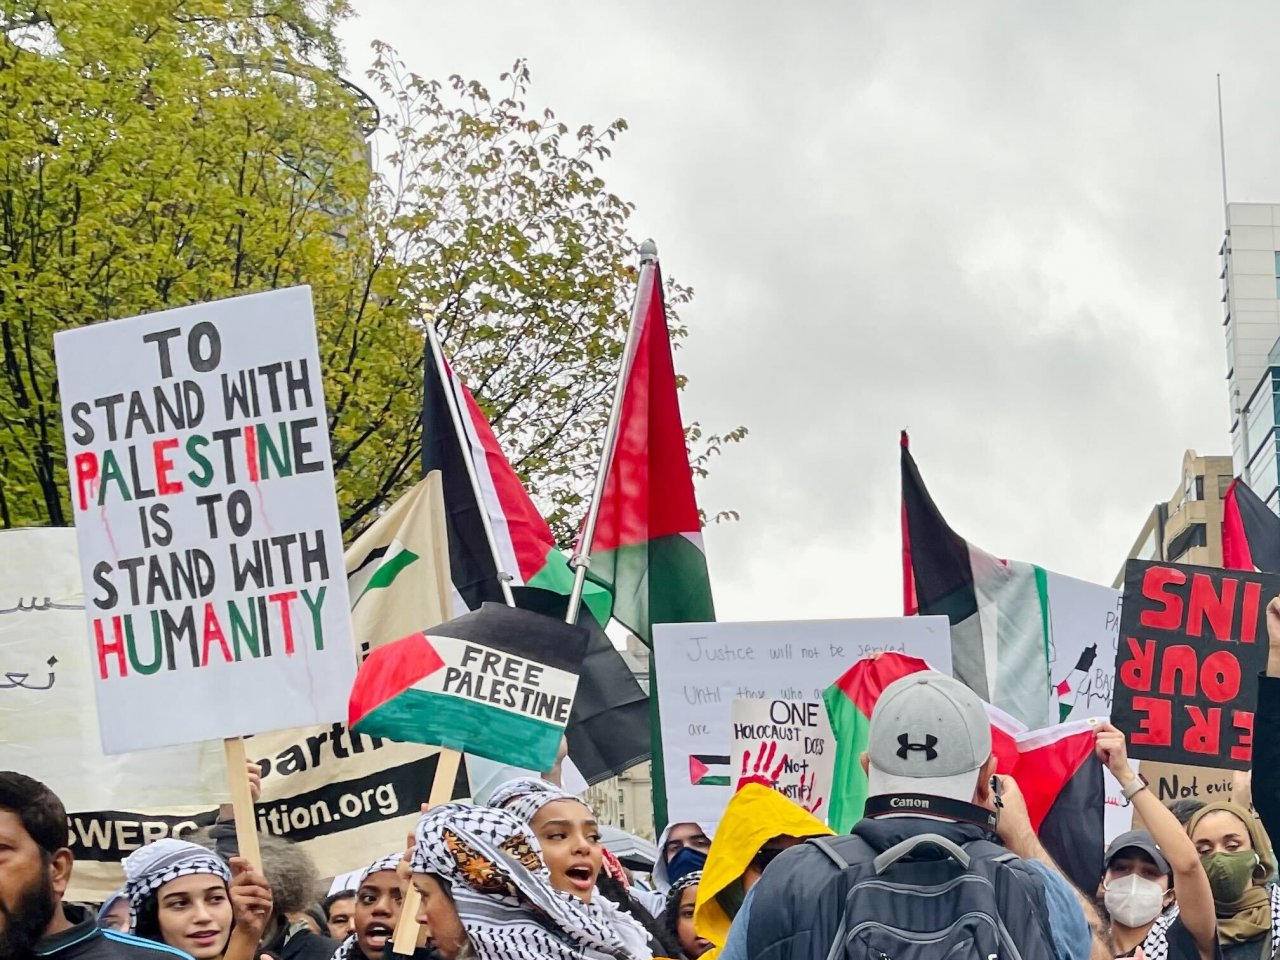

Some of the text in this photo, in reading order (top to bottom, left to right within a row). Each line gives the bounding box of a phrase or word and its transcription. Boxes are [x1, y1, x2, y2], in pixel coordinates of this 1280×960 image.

[143, 321, 221, 379] TO
[71, 358, 313, 446] STAND WITH
[74, 417, 325, 511] PALESTINE
[138, 489, 252, 548] IS TO
[92, 529, 330, 610] STAND WITH
[1140, 565, 1263, 644] INS
[93, 586, 328, 680] HUMANITY
[687, 637, 756, 662] Justice
[769, 643, 793, 660] will
[801, 646, 821, 659] not
[830, 643, 846, 657] be
[460, 645, 544, 687] FREE
[1119, 637, 1242, 703] OUR
[442, 667, 572, 723] PALESTINE
[683, 685, 722, 706] Until
[780, 687, 803, 700] who
[769, 700, 819, 727] ONE
[688, 723, 710, 736] are
[734, 723, 802, 741] HOLOCAUST
[804, 737, 825, 755] DOES
[889, 797, 930, 809] Canon
[1158, 774, 1200, 801] Not
